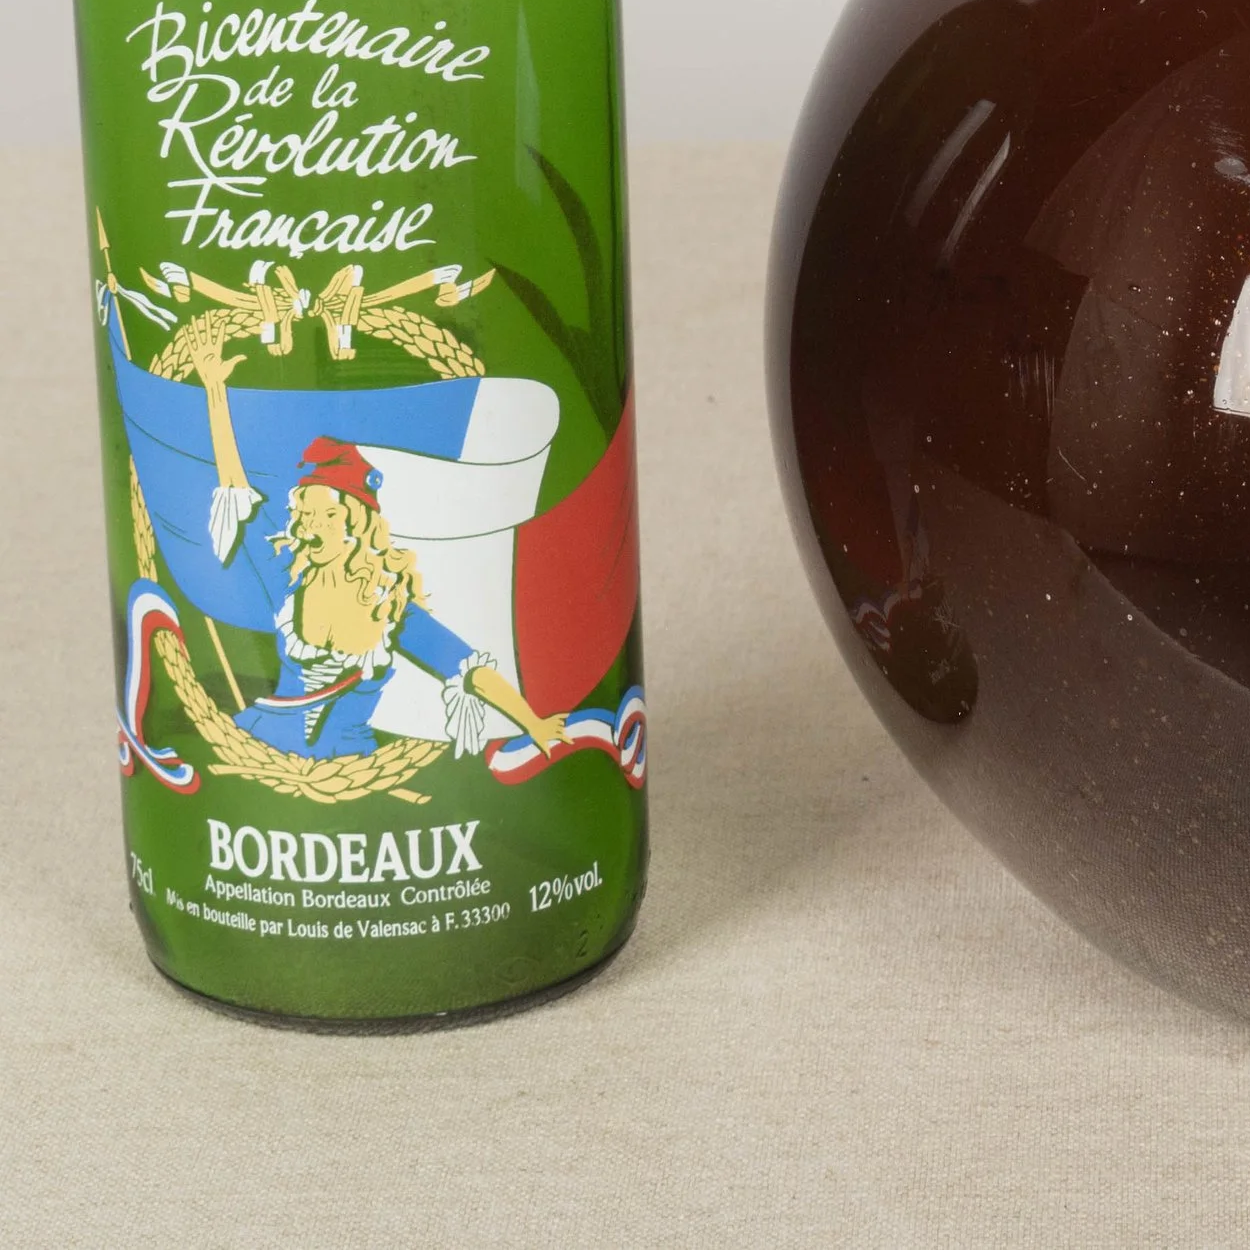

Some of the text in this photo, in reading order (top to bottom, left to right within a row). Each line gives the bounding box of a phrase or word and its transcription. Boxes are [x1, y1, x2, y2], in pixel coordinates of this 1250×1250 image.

[243, 63, 359, 109] de la
[147, 74, 478, 197] Révolution
[165, 176, 436, 259] Française
[206, 818, 483, 884] BORDEAUX
[166, 887, 185, 911] Mis
[186, 901, 201, 918] en
[203, 902, 256, 931] bouteille
[260, 920, 284, 937] par
[287, 918, 329, 938] Louis
[333, 921, 353, 938] de
[357, 920, 427, 938] Valensac
[431, 915, 441, 933] à
[205, 874, 491, 909] Appellation Bordeaux Contrôlée
